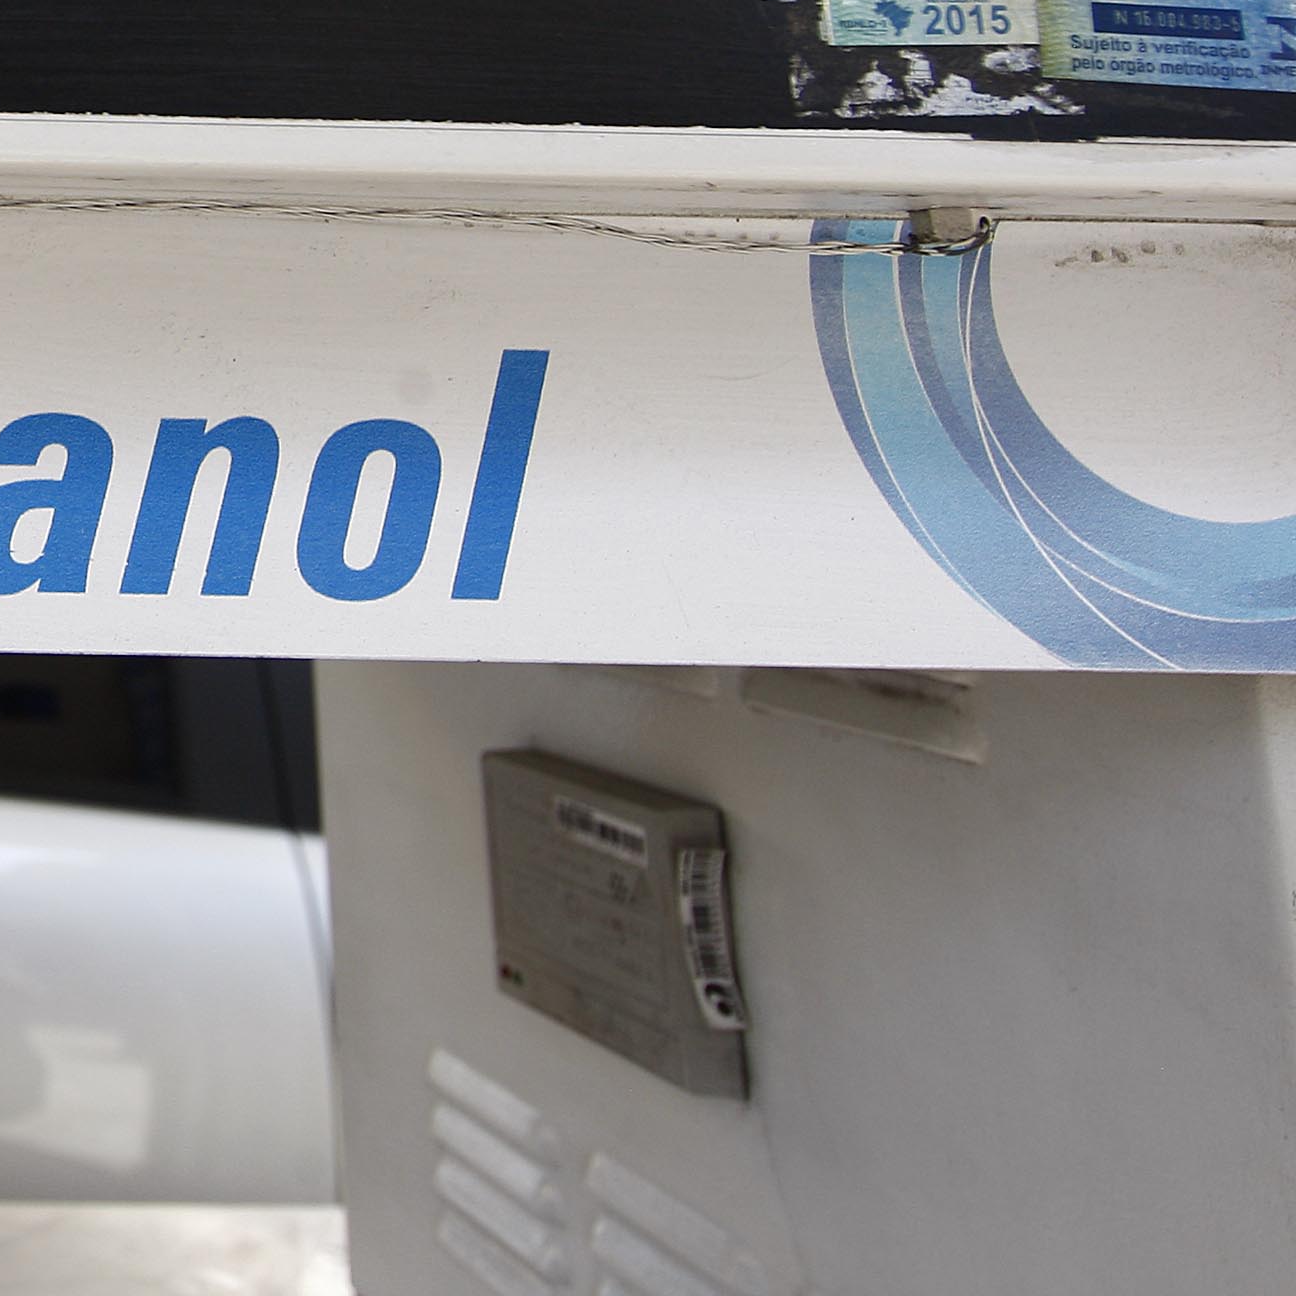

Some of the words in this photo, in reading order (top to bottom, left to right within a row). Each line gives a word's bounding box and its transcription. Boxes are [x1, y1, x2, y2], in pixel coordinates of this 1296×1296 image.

[921, 4, 1012, 36] 2015
[1070, 33, 1133, 54] Sujeito
[1152, 40, 1251, 61] verificação
[1071, 55, 1105, 73] pelo
[1110, 55, 1156, 77] órgão
